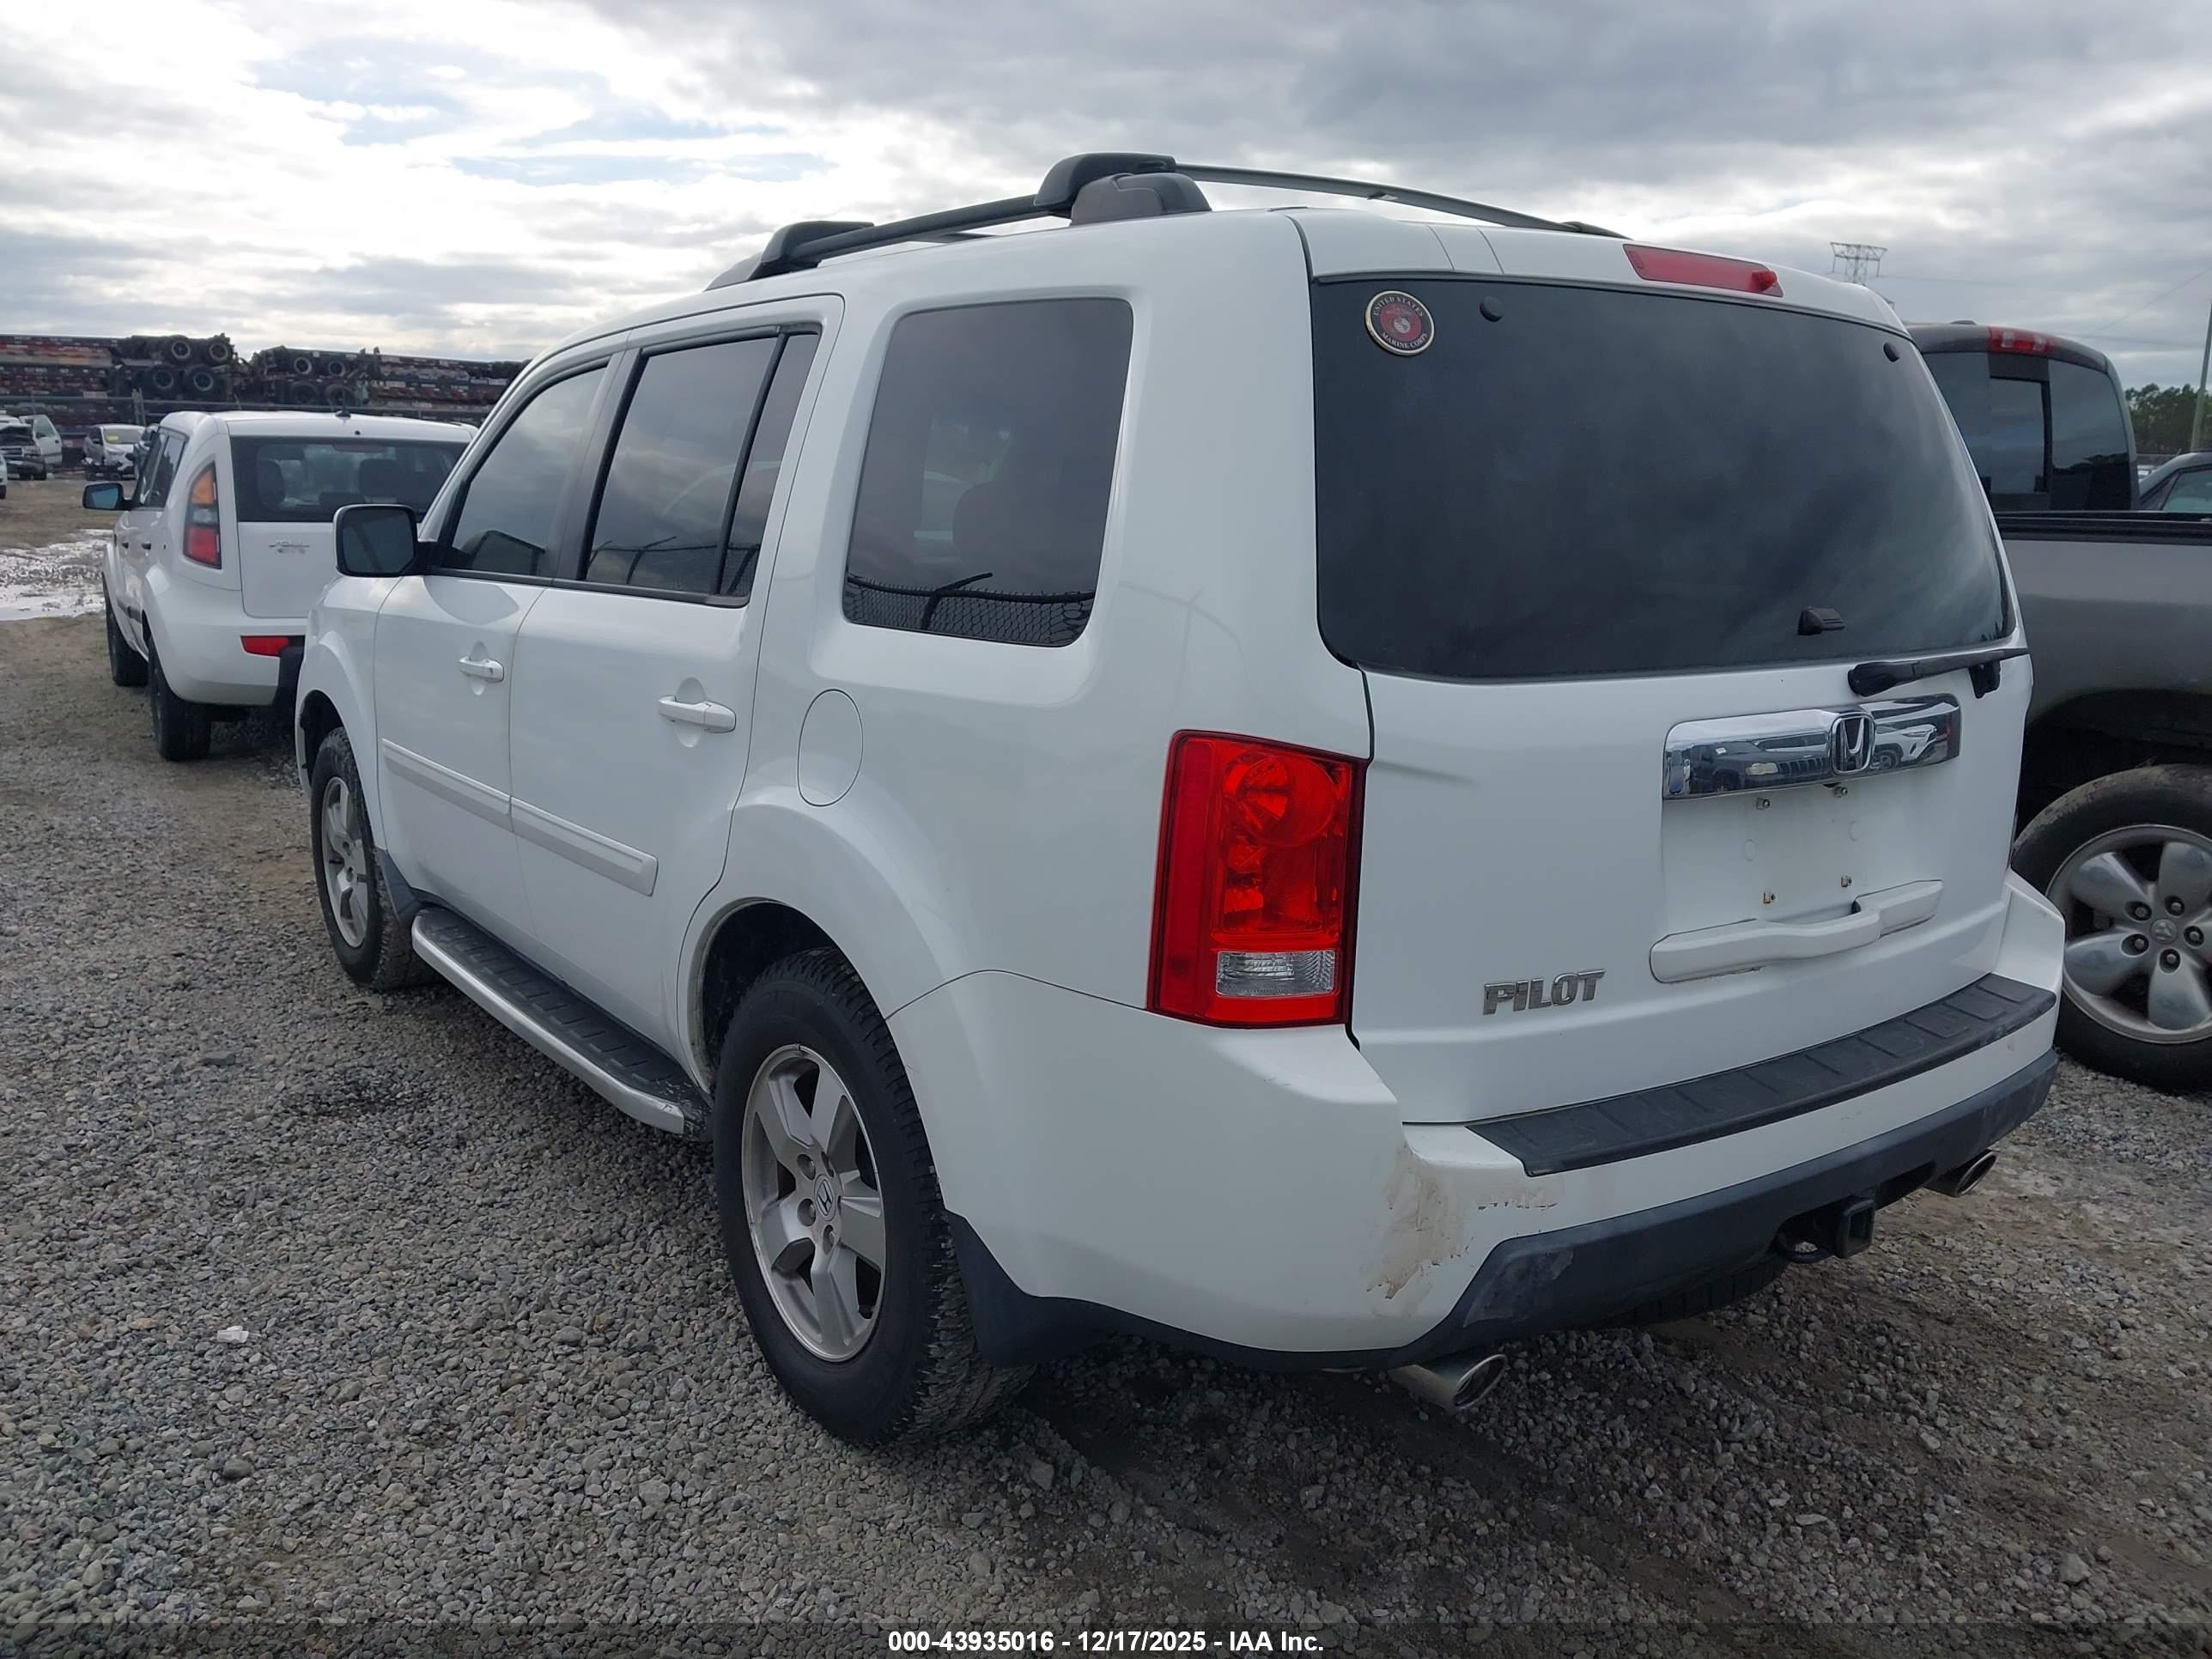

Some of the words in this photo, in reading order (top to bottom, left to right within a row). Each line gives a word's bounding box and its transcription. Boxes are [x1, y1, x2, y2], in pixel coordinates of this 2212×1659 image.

[1374, 296, 1395, 316] UNITED
[1396, 296, 1424, 317] STATES
[1382, 332, 1409, 349] MARINE
[1410, 333, 1427, 348] CORPS
[1483, 969, 1606, 1015] PILOT
